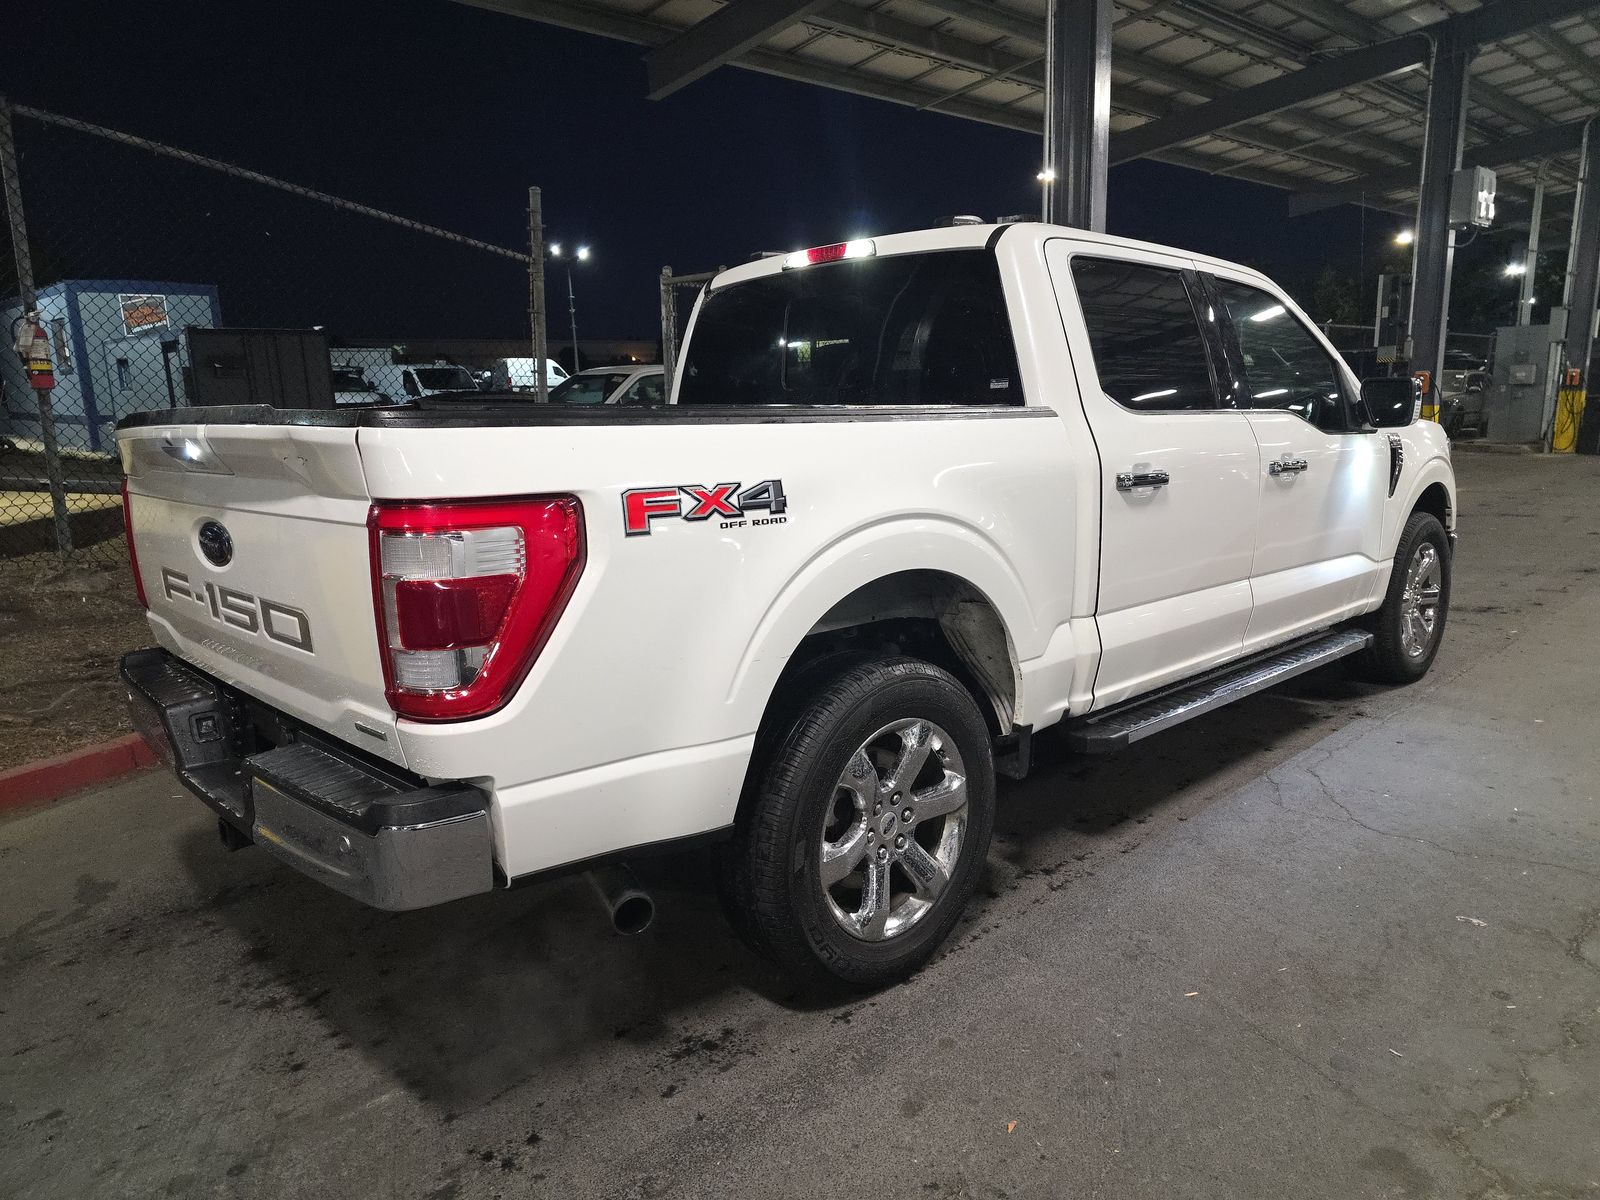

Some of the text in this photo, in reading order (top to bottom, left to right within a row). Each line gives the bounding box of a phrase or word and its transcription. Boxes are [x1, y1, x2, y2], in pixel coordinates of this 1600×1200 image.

[621, 478, 787, 537] FX4
[719, 516, 787, 530] OFF ROAD
[161, 566, 315, 656] F-150
